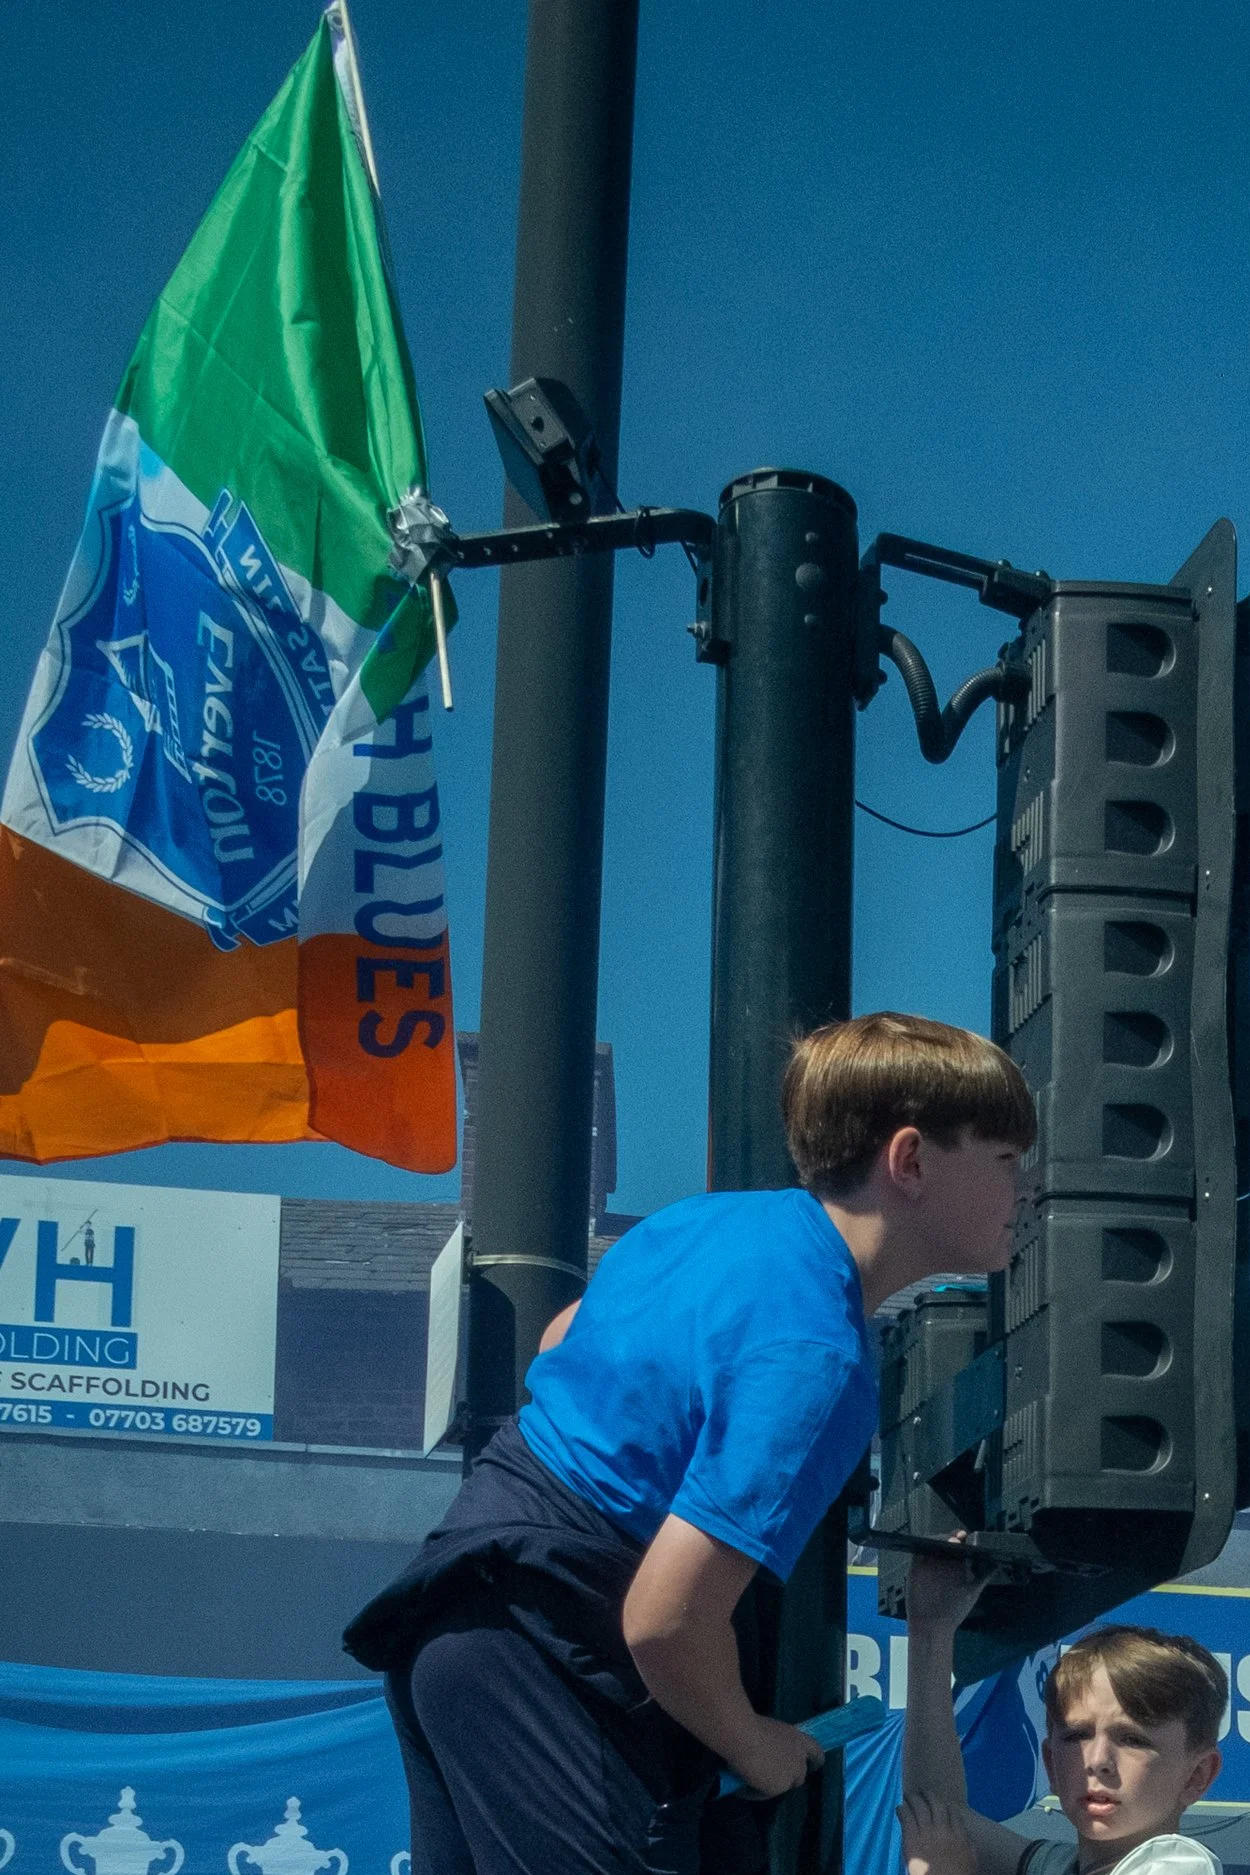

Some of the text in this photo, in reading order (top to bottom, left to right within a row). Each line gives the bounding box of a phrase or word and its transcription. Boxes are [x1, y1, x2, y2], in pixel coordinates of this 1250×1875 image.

[353, 781, 445, 1058] BLUES
[0, 1332, 131, 1366] LDING
[11, 1372, 211, 1402] SCAFFOLDING
[89, 1408, 166, 1431] 07703
[171, 1414, 262, 1438] 687579
